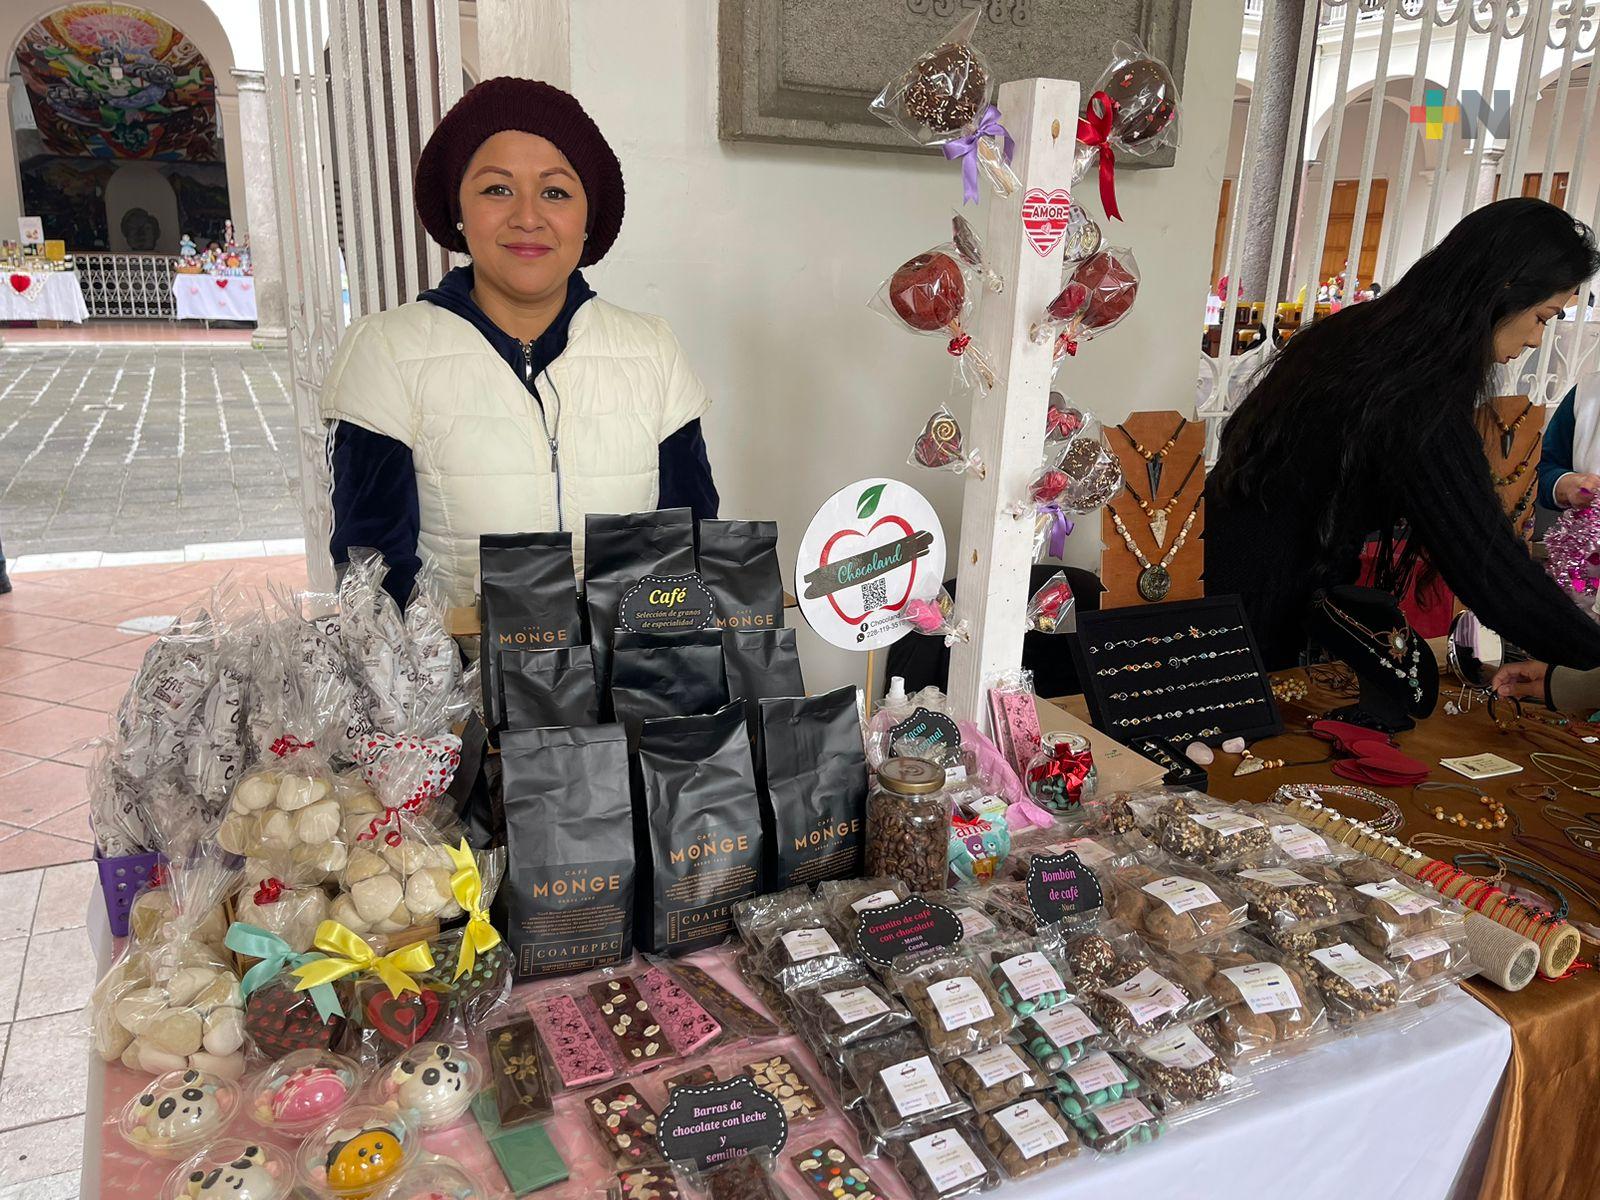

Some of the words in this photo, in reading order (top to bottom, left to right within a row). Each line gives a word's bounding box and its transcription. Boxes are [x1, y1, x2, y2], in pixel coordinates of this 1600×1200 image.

[1032, 205, 1064, 218] AMOR
[838, 543, 903, 584] Chocoland
[649, 587, 687, 608] Café
[635, 610, 667, 619] Selección
[668, 609, 677, 617] de
[678, 609, 701, 618] granos
[716, 614, 774, 628] MONGE
[870, 613, 901, 628] Chocoland
[651, 618, 694, 629] especialidad
[499, 629, 567, 645] MONGE
[794, 819, 860, 851] MONGE
[669, 835, 748, 864] MONGE
[565, 867, 588, 877] CAFÉ
[1041, 868, 1077, 883] Bombón
[533, 874, 620, 898] MONGE
[1049, 888, 1060, 901] de
[1060, 886, 1079, 901] café
[903, 914, 913, 925] de
[914, 908, 932, 921] café
[879, 933, 895, 944] con
[895, 919, 935, 938] chocolate
[536, 940, 619, 959] COATEPEC
[693, 1102, 728, 1118] Barras
[729, 1100, 742, 1110] de
[672, 1120, 720, 1138] chocolate
[722, 1117, 740, 1128] con
[741, 1110, 767, 1124] leche
[719, 1135, 727, 1147] y
[706, 1146, 748, 1164] semillas
